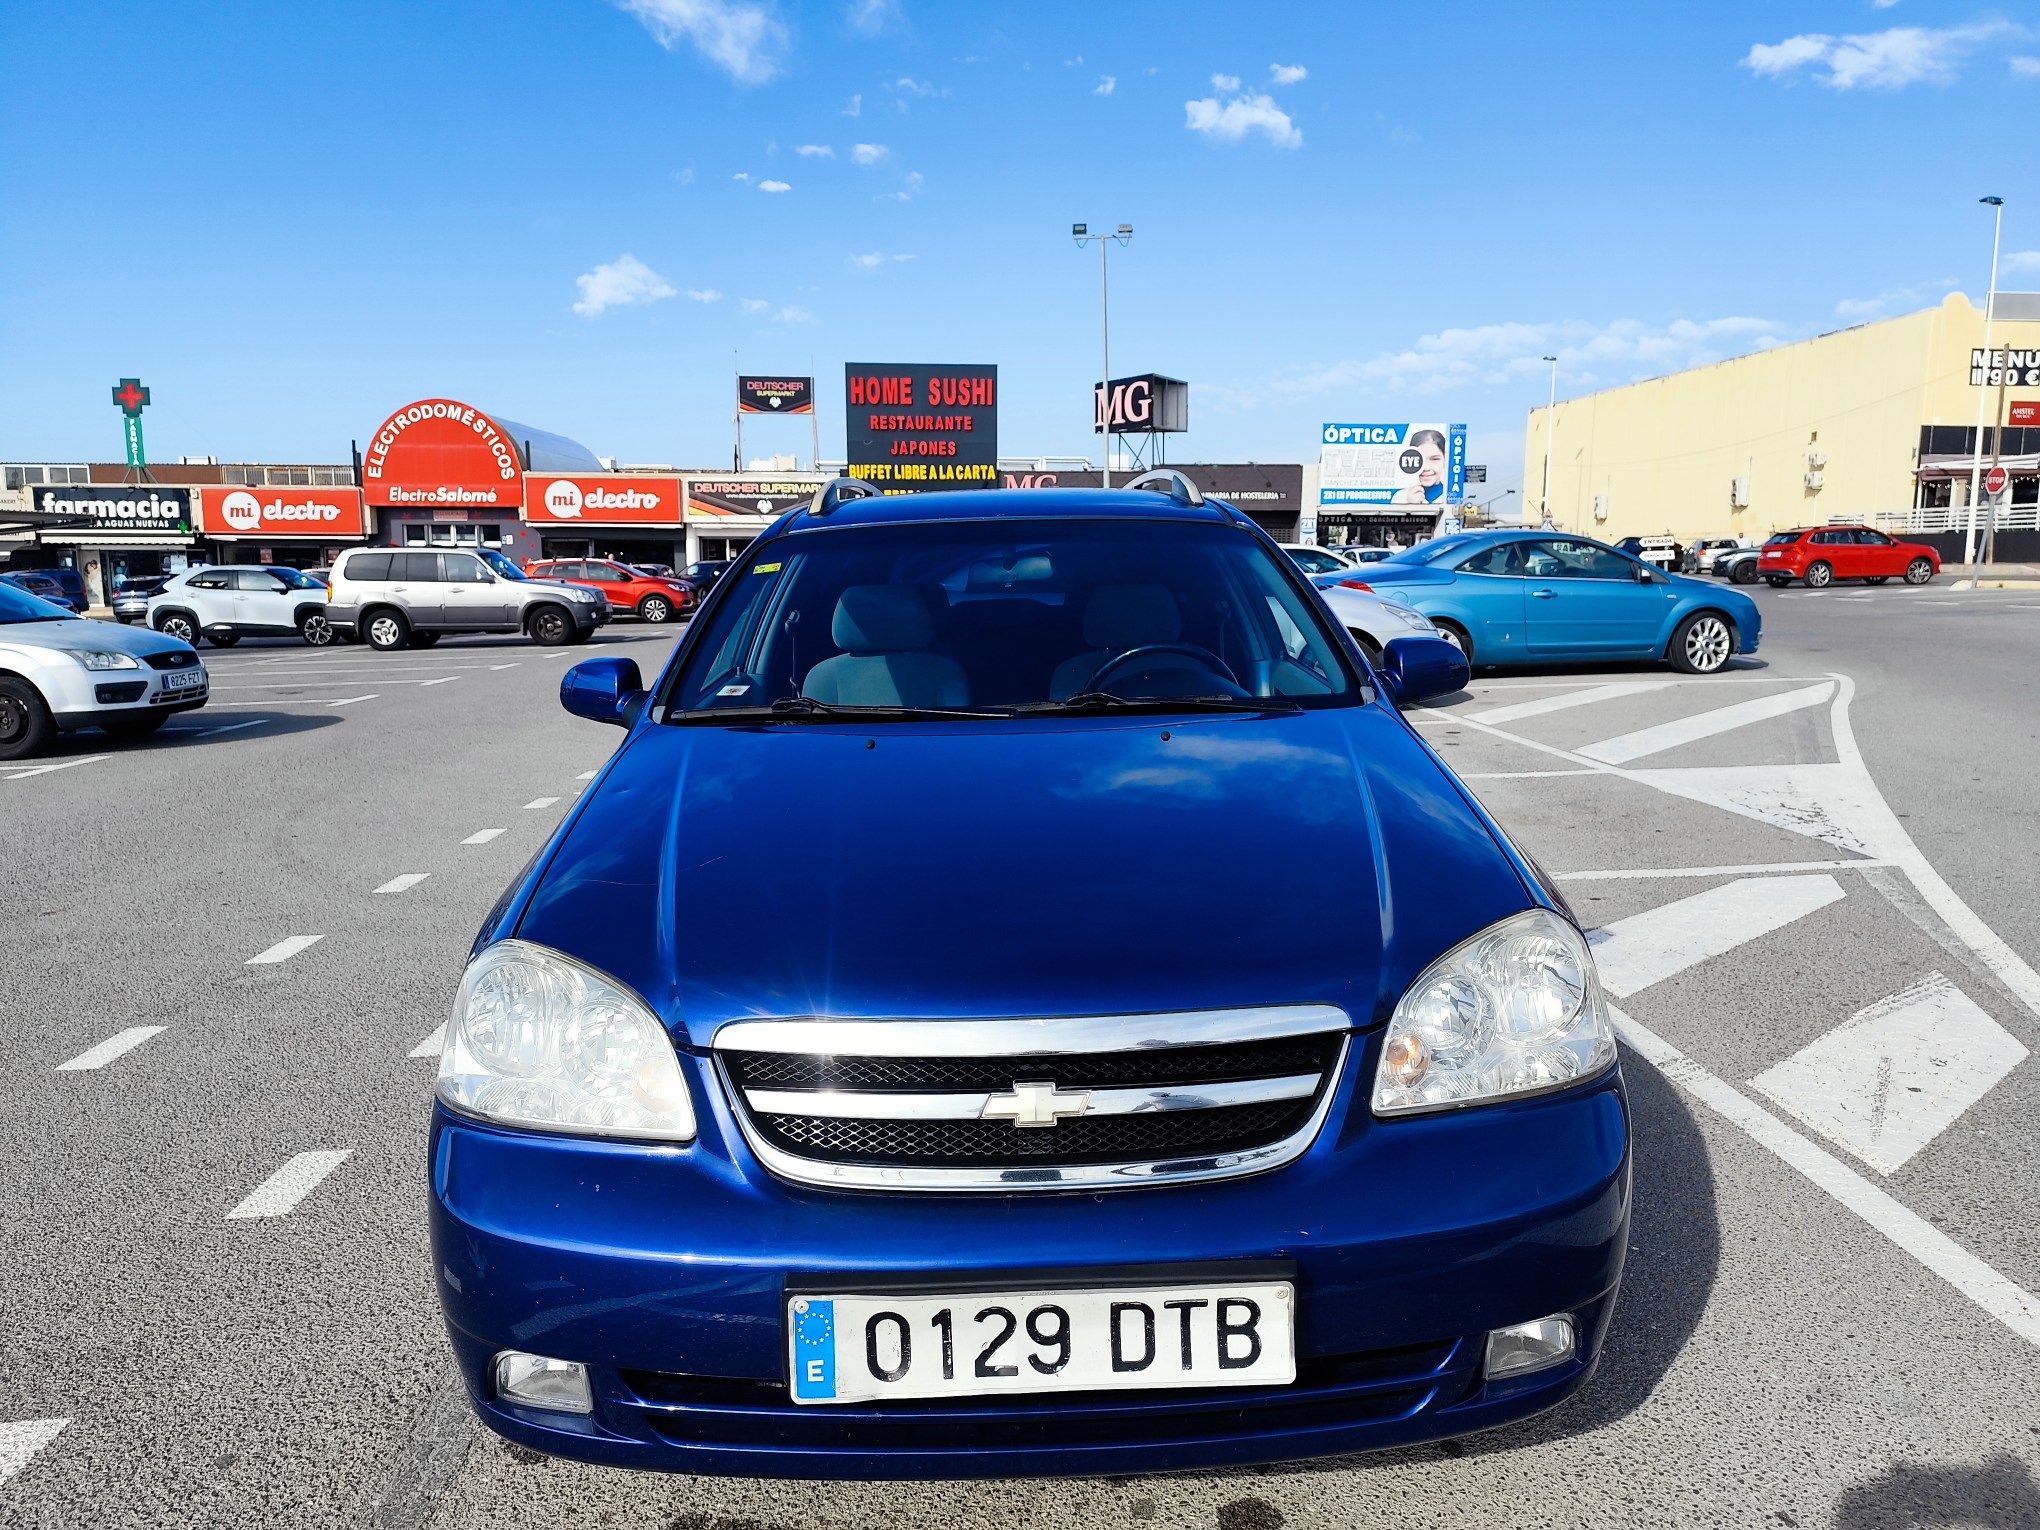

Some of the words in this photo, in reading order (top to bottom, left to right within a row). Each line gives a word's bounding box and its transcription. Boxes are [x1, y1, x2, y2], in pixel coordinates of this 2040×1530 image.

[746, 381, 804, 391] DEUTSCHER
[850, 377, 913, 405] HOME
[928, 378, 993, 406] SUSHI
[1095, 381, 1152, 427] MG
[870, 415, 973, 431] RESTAURANTE
[367, 403, 515, 480] ELECTRODOMÉSTICOS
[1324, 425, 1399, 443] ÓPTICA
[890, 440, 957, 456] JAPONES
[1401, 456, 1420, 468] EYE
[848, 464, 892, 480] BUFFET
[894, 465, 927, 480] LIBRE
[928, 465, 938, 480] A
[939, 465, 955, 480] LA
[956, 465, 996, 480] CARTA
[694, 483, 759, 493] DEUTSCHER
[760, 483, 825, 493] SUPERMAR
[1988, 476, 2005, 485] STOP
[389, 486, 498, 503] ElectroSalomé
[552, 491, 576, 506] mi
[584, 487, 661, 510] electro
[1231, 491, 1240, 500] DE
[42, 492, 180, 518] farmacia
[229, 503, 255, 518] mi
[263, 498, 341, 521] electro
[104, 519, 134, 528] AGUAS
[136, 519, 169, 528] NUEVAS
[171, 674, 187, 687] 8225
[188, 671, 200, 684] FZT
[865, 1303, 1072, 1383] 0129
[1110, 1297, 1262, 1373] DTB
[807, 1360, 825, 1383] E
